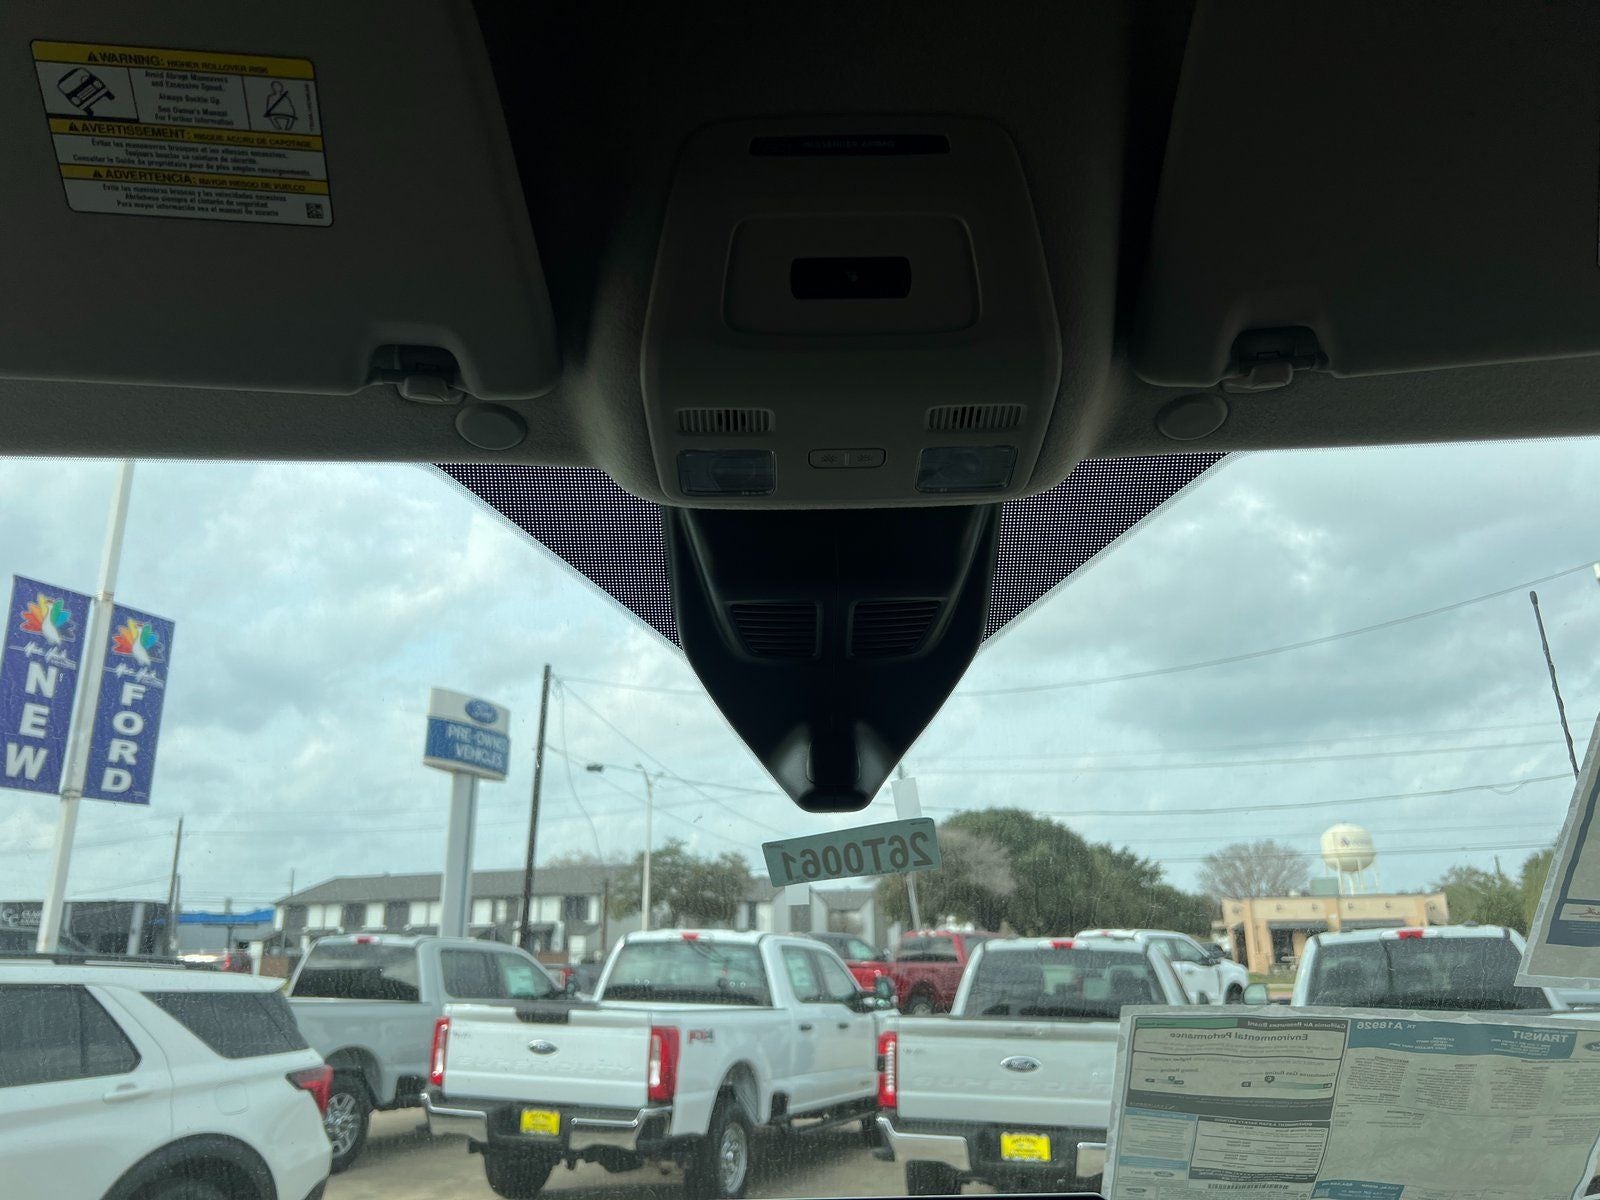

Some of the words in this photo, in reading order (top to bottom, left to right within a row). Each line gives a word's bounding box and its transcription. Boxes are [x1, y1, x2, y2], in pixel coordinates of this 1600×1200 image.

[98, 52, 163, 66] WARNING:
[167, 61, 200, 70] HIGHER
[202, 63, 247, 73] ROLLOVER
[248, 66, 268, 74] RISK
[105, 169, 196, 185] ADVERTENCIA:
[5, 661, 58, 783] NEW
[100, 681, 147, 794] FORD
